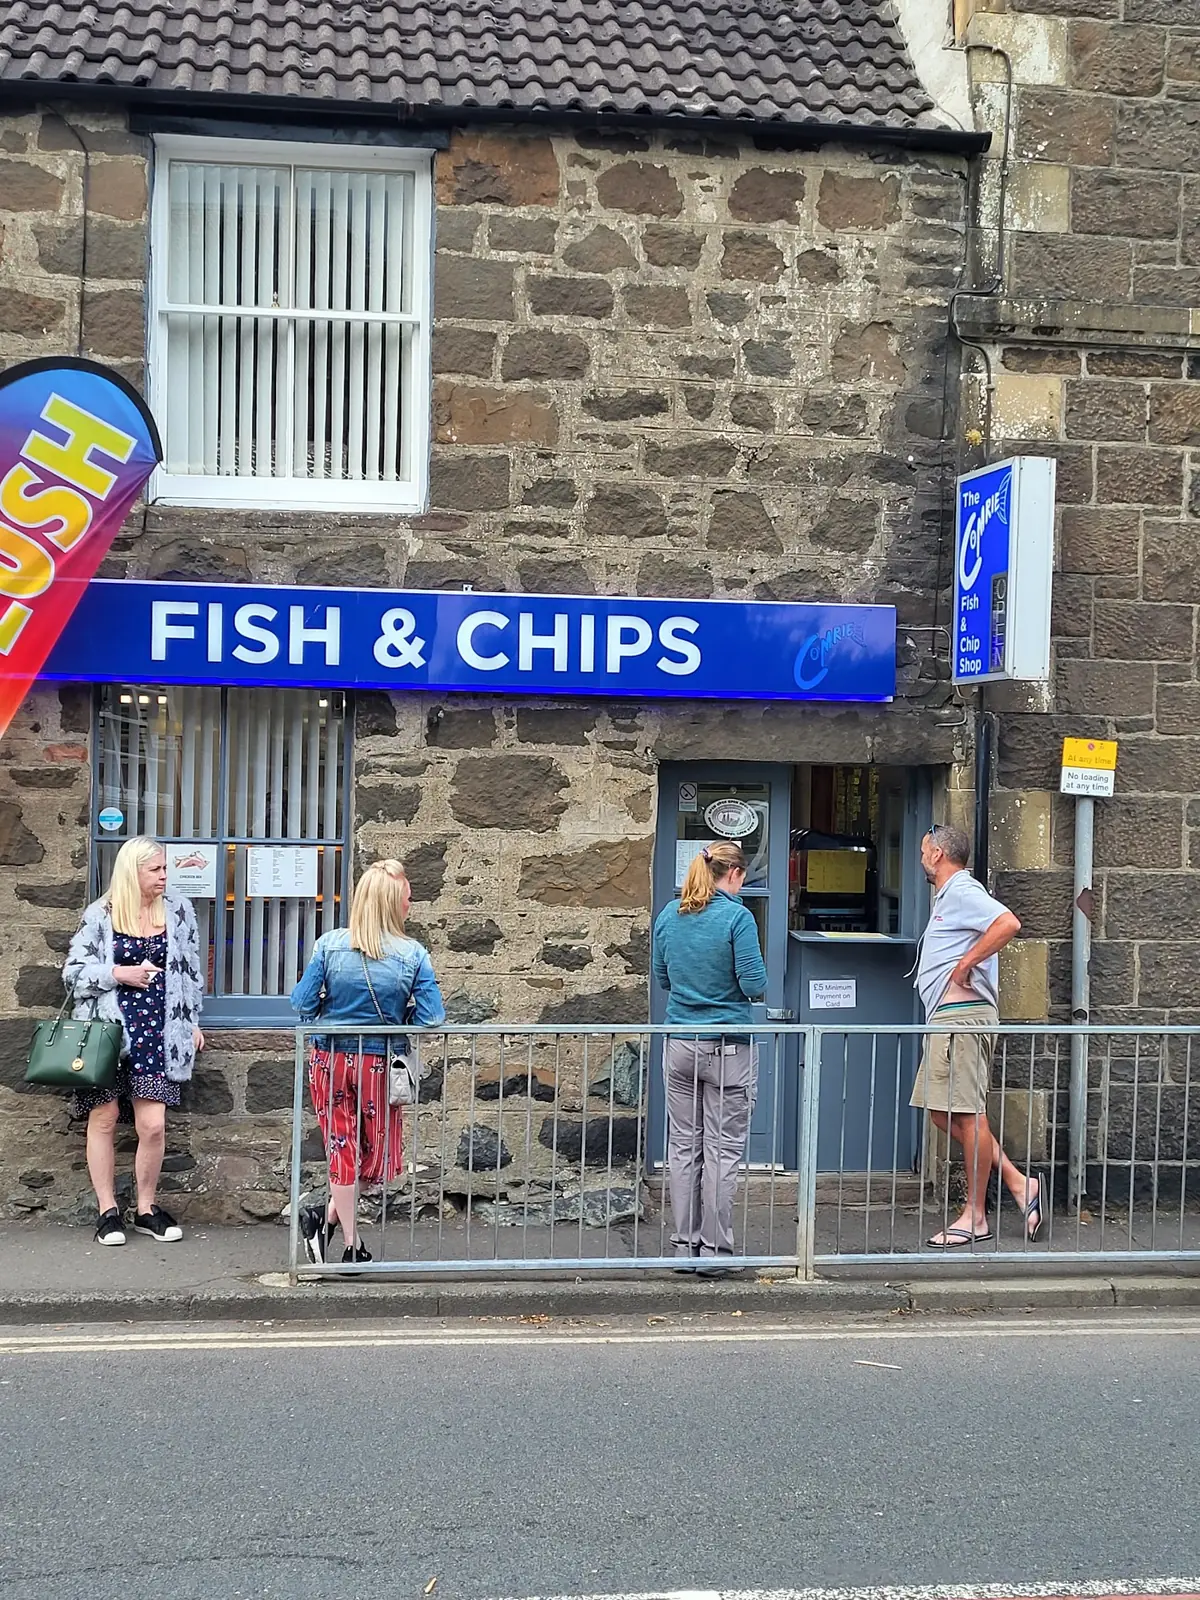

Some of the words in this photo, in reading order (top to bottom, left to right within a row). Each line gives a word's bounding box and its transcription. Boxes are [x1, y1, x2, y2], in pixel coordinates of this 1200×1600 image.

[962, 490, 980, 508] The
[959, 491, 1000, 591] COMRIE
[961, 593, 979, 612] Fish
[960, 616, 967, 632] &
[151, 600, 341, 666] FISH
[373, 607, 426, 669] &
[456, 610, 702, 676] CHIPS
[960, 635, 980, 654] Chip
[793, 622, 855, 690] COMRIE
[959, 657, 982, 675] Shop
[1067, 754, 1077, 762] At
[1078, 756, 1092, 764] any
[1094, 757, 1112, 765] time
[1081, 773, 1109, 783] loading
[1092, 783, 1109, 791] time
[813, 983, 824, 991] £5
[815, 993, 841, 1001] Payment
